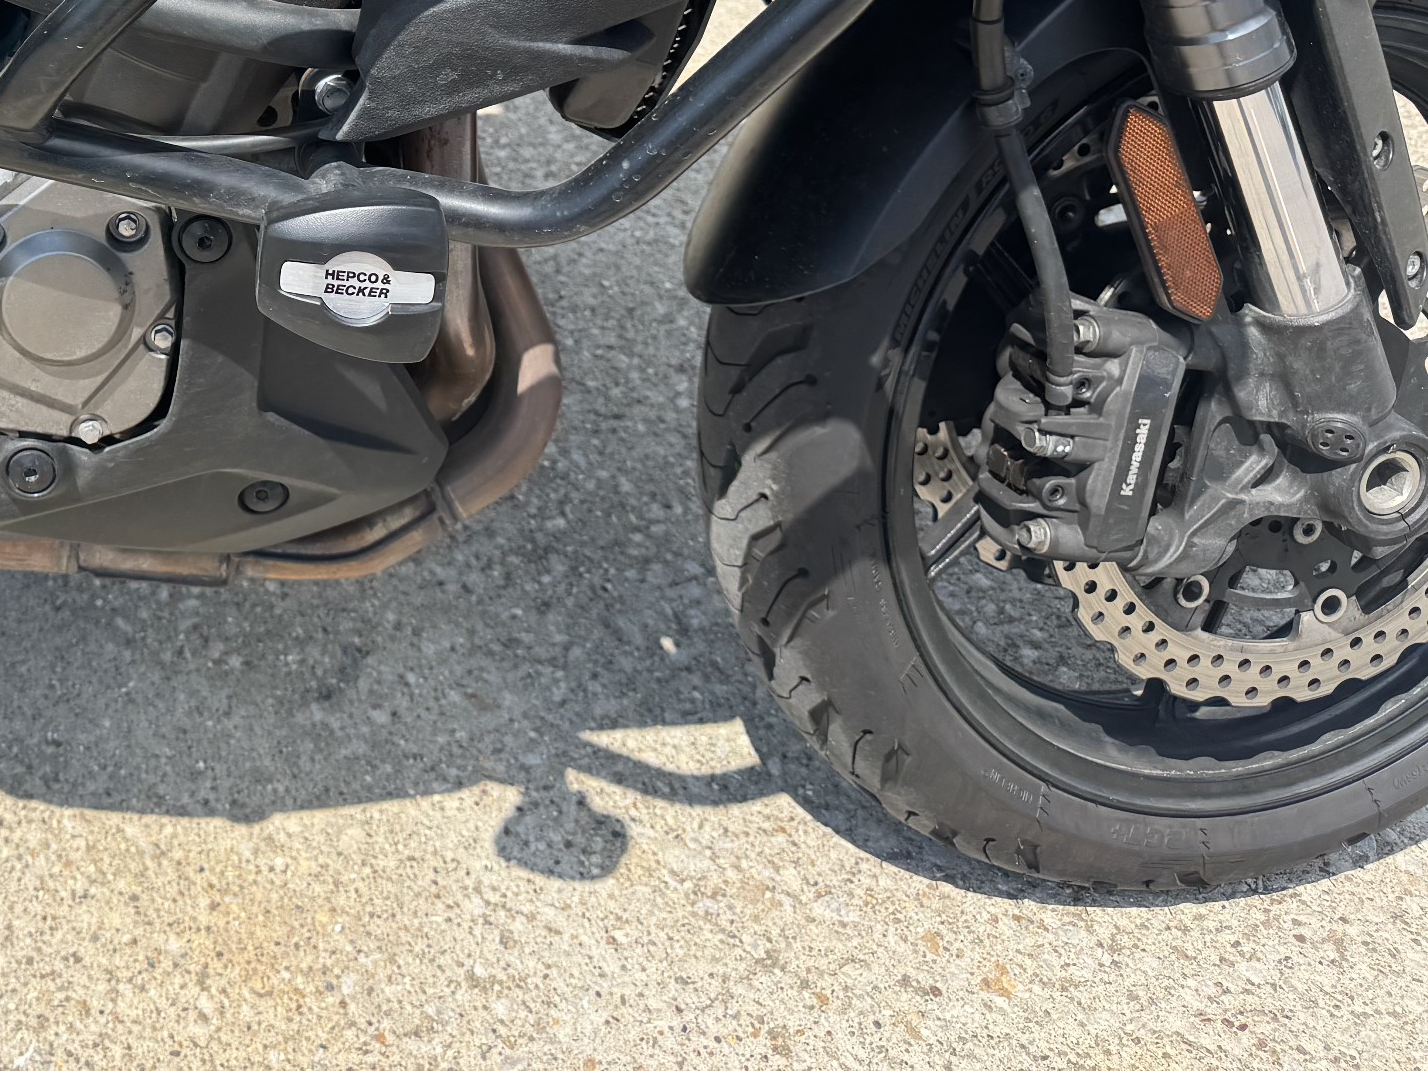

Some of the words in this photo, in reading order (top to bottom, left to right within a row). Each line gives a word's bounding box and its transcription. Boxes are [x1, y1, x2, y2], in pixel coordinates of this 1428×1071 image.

[323, 283, 390, 299] BECKER
[324, 269, 379, 284] HEPCO
[380, 273, 392, 285] &
[891, 204, 968, 346] MICHELIN
[1120, 418, 1151, 496] Kawasaki
